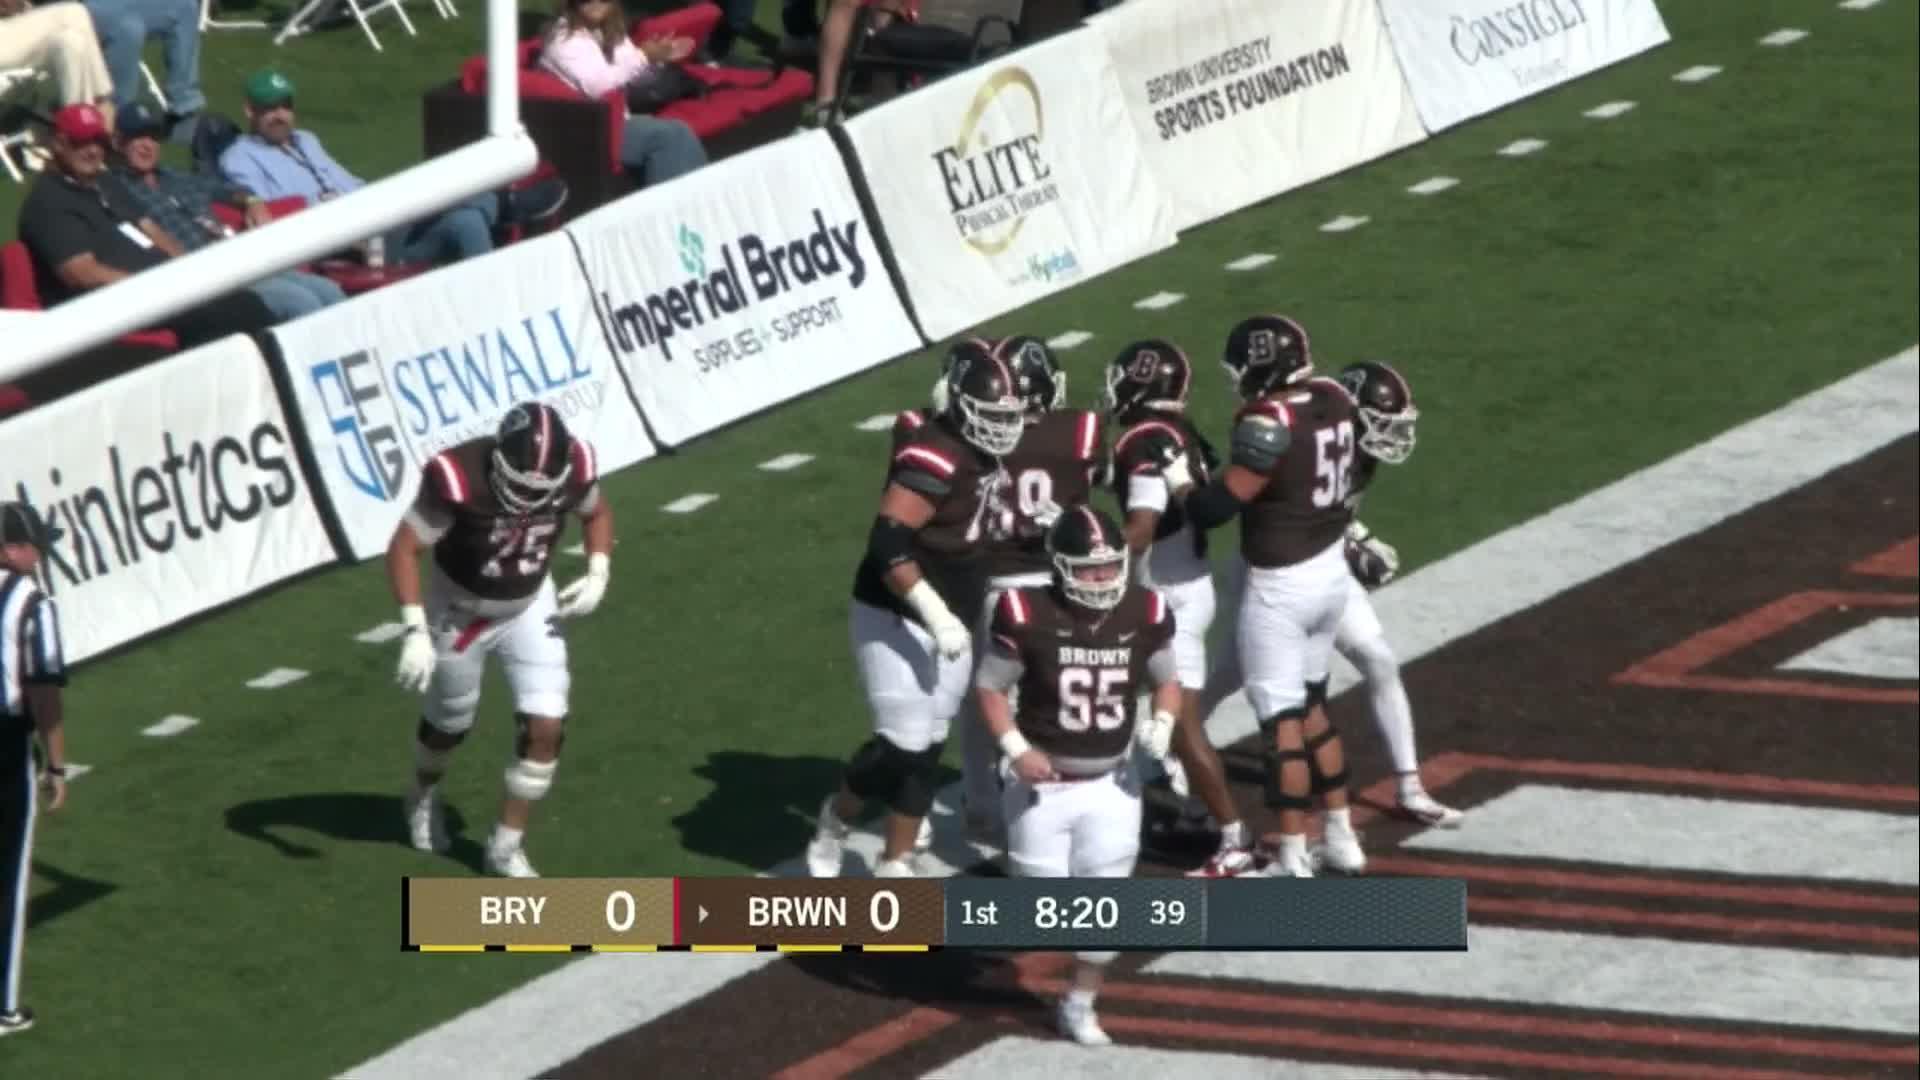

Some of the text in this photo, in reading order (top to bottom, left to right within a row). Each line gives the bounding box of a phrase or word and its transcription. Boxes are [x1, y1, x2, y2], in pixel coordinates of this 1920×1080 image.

[1145, 36, 1272, 104] BROWN UNIVERSITY
[1154, 42, 1350, 141] SPORTS FOUNDATION
[931, 133, 1050, 213] ELITE
[602, 208, 866, 361] Imperial Brady
[393, 308, 592, 436] SEWALL
[693, 328, 763, 373] SUPPLIES
[770, 297, 843, 343] SUPPORT
[1311, 420, 1355, 508] 52
[1058, 647, 1132, 665] BROWN
[1058, 667, 1129, 732] 65
